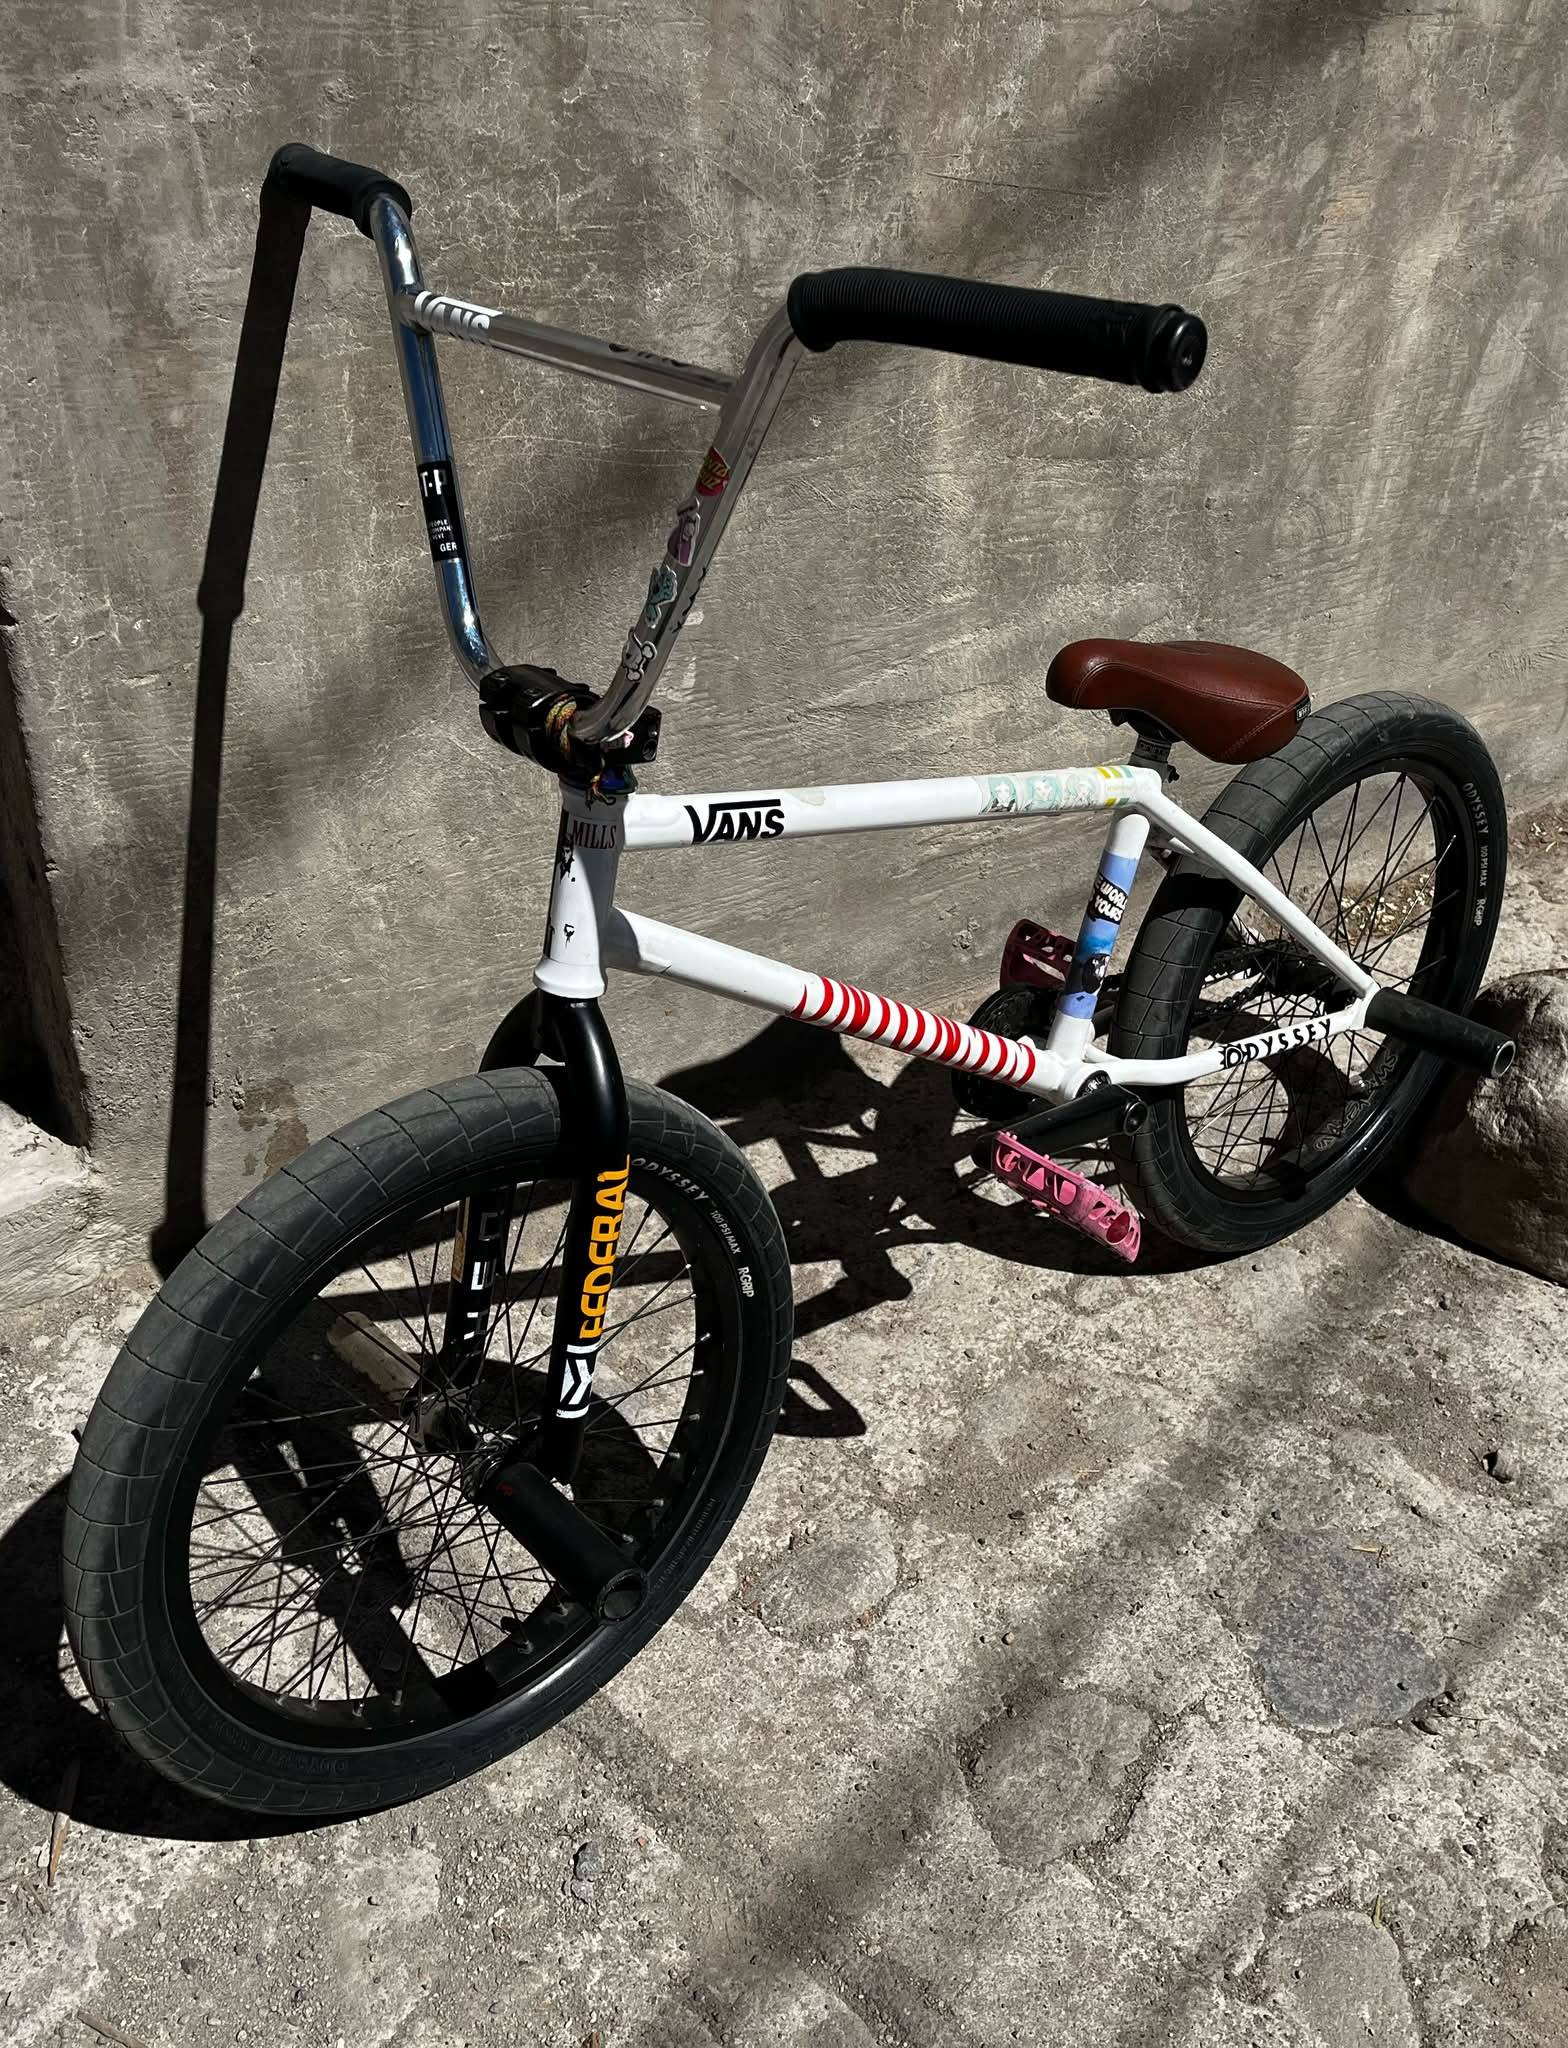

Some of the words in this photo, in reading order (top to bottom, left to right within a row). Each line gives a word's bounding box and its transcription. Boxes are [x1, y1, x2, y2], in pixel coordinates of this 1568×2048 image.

[684, 799, 785, 845] VANS
[1462, 782, 1489, 834] ODYSSEY
[573, 820, 617, 850] MILLS
[1219, 1018, 1331, 1069] ODYSSEY
[632, 1157, 709, 1200] ODYSSEY
[709, 1210, 725, 1224] 100
[719, 1223, 732, 1235] PSI
[579, 1154, 630, 1339] FEDERAL
[725, 1235, 742, 1255] MAX
